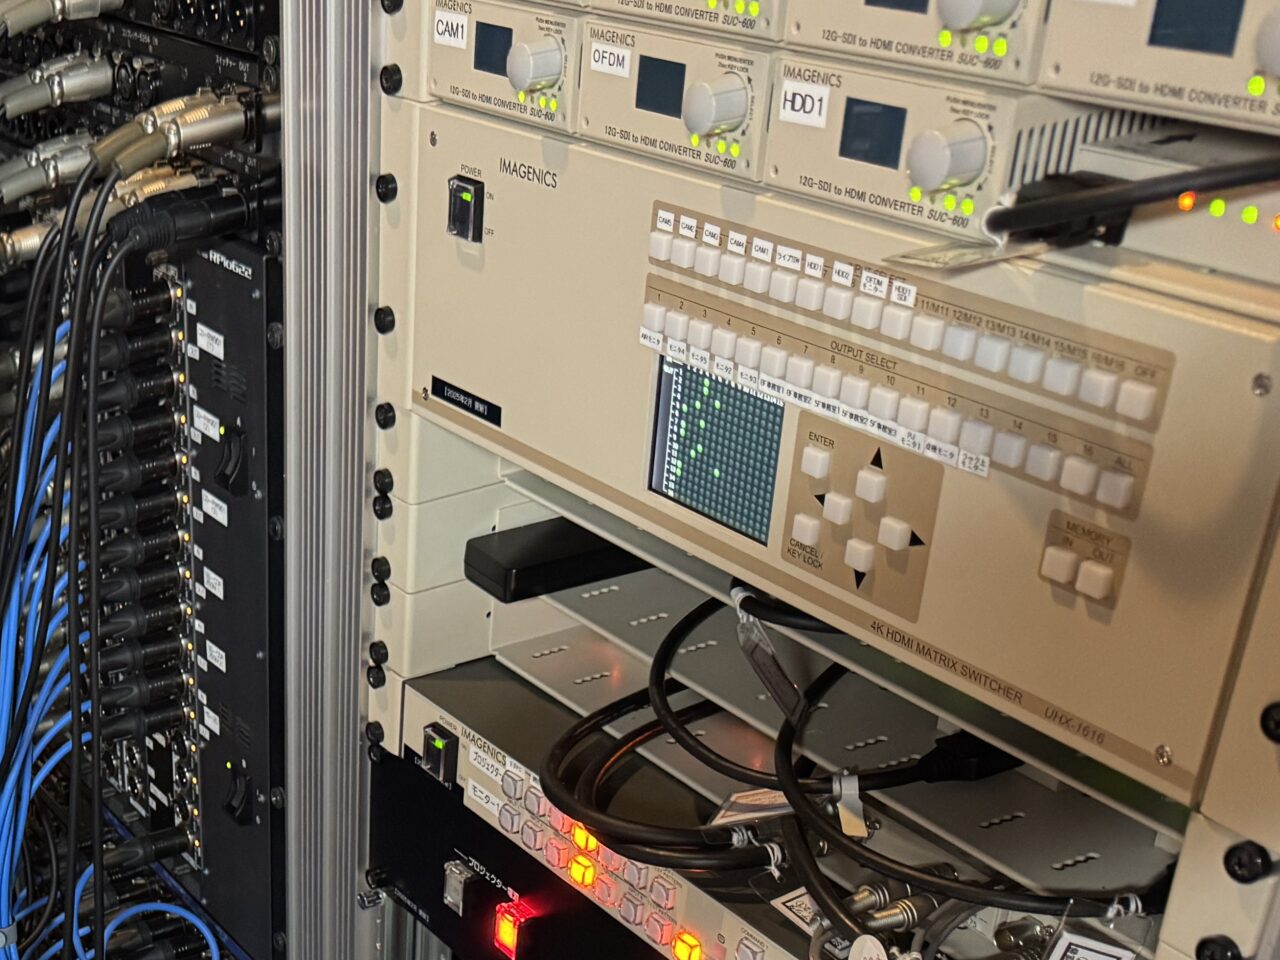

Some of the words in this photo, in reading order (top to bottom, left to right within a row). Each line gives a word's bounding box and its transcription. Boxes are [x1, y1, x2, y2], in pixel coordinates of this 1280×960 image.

[436, 19, 464, 40] CAM1
[646, 2, 653, 10] to
[655, 3, 672, 15] HDMI
[674, 4, 718, 22] CONVERTER
[722, 15, 756, 29] SUC-600
[590, 27, 635, 47] IMAGENICS
[822, 29, 856, 42] 12G-SDI
[859, 36, 867, 46] to
[870, 38, 893, 51] HDMI
[895, 42, 954, 61] CONVERTER
[593, 49, 625, 69] OFDM
[783, 64, 842, 88] IMAGENICS
[450, 85, 470, 102] 12G-SDI
[472, 93, 478, 101] to
[478, 94, 492, 106] HDMI
[493, 96, 528, 115] CONVERTER
[529, 105, 555, 121] SUC-600
[1138, 82, 1150, 93] to
[1154, 83, 1185, 99] HDMI
[1187, 88, 1268, 113] CONVERTER
[604, 125, 631, 141] 12G-SDI
[632, 133, 639, 143] to
[640, 135, 657, 149] HDMI
[659, 139, 701, 160] CONVERTER
[704, 153, 736, 169] SUC-600
[460, 164, 482, 178] POWER
[500, 158, 557, 188] IMAGENICS
[799, 175, 832, 193] 12G-SDI
[834, 185, 842, 195] to
[844, 186, 866, 202] HDMI
[869, 193, 923, 216] CONVERTER
[927, 209, 969, 228] SUC-600
[831, 341, 863, 359] OUTPUT
[866, 353, 898, 370] SELECT
[887, 375, 895, 386] 10
[948, 396, 957, 407] 12
[980, 407, 989, 418] 13
[808, 432, 835, 448] ENTER
[787, 546, 802, 559] KEY
[803, 555, 823, 570] LOCK
[870, 620, 885, 637] 4K
[885, 627, 914, 652] HDMI
[915, 641, 958, 673] MATRIX
[960, 664, 1024, 705] SWITCHER
[1043, 706, 1105, 745] UHX-1616
[461, 726, 507, 767] IMAGENICS
[473, 751, 503, 777] プロジェクター
[469, 857, 507, 891] プロジェクター
